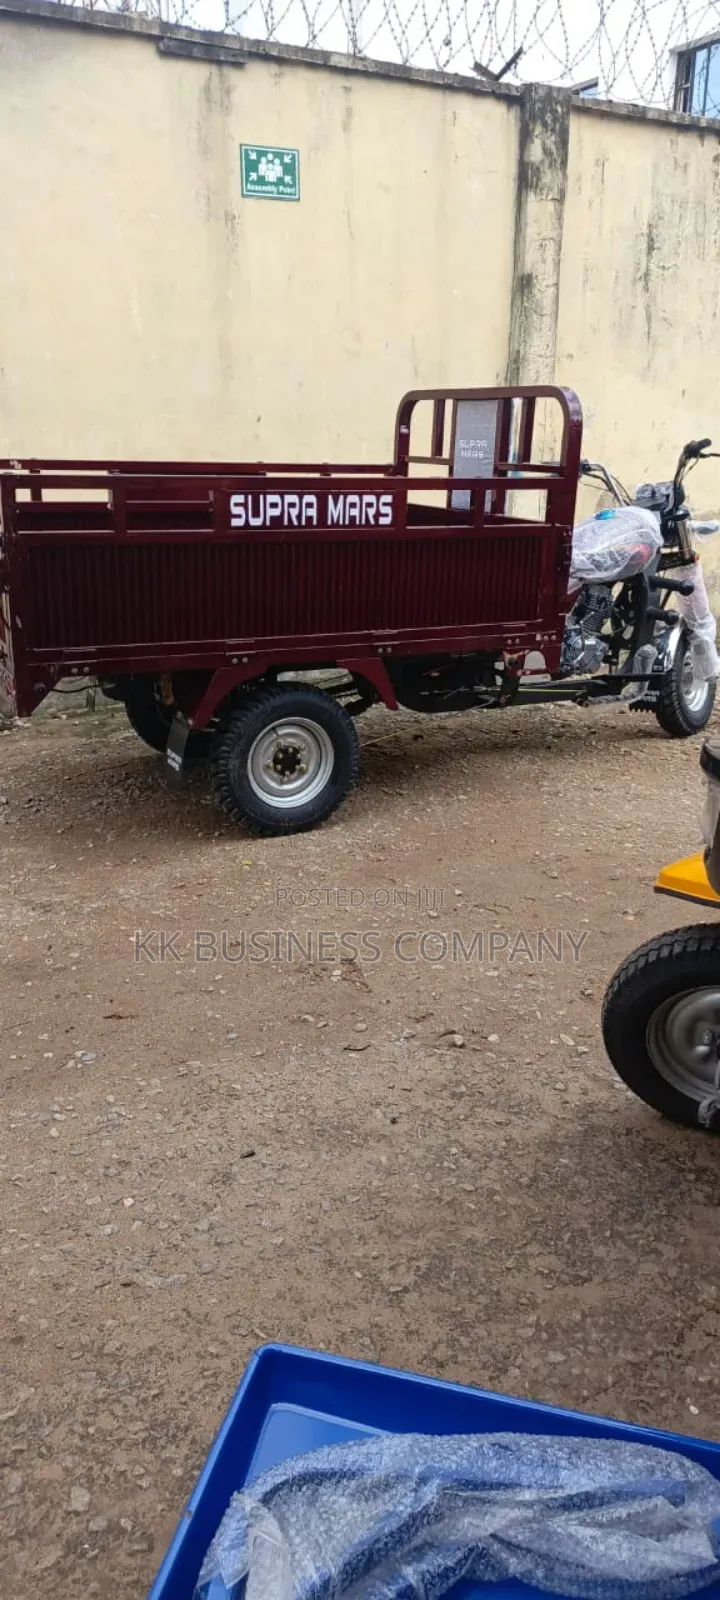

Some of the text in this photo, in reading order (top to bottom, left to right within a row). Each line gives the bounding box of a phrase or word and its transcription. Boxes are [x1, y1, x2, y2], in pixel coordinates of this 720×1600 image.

[247, 183, 296, 194] Assembly Point
[230, 494, 394, 526] SUPRA MARS
